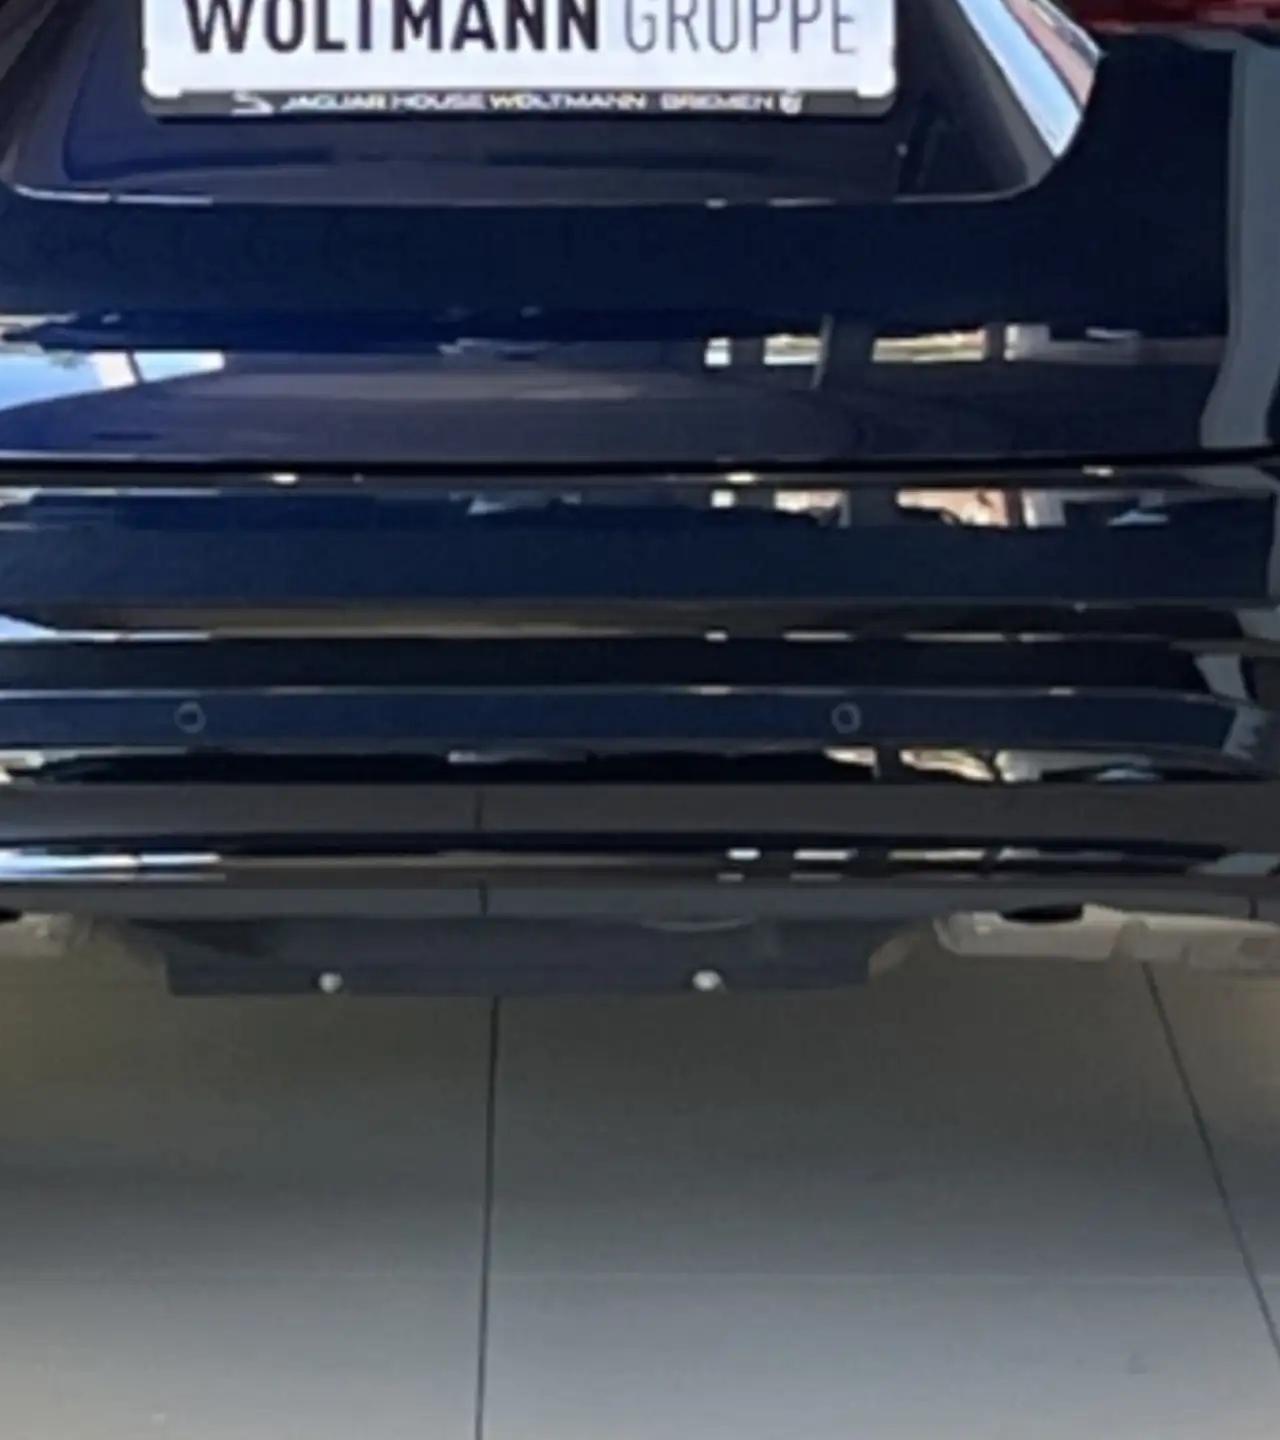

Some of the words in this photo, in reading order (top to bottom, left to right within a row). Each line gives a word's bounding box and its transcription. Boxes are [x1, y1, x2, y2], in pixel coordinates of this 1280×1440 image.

[281, 93, 387, 112] JAGUAR
[392, 93, 486, 112] HOUSE
[489, 93, 647, 112] WOLTMANN
